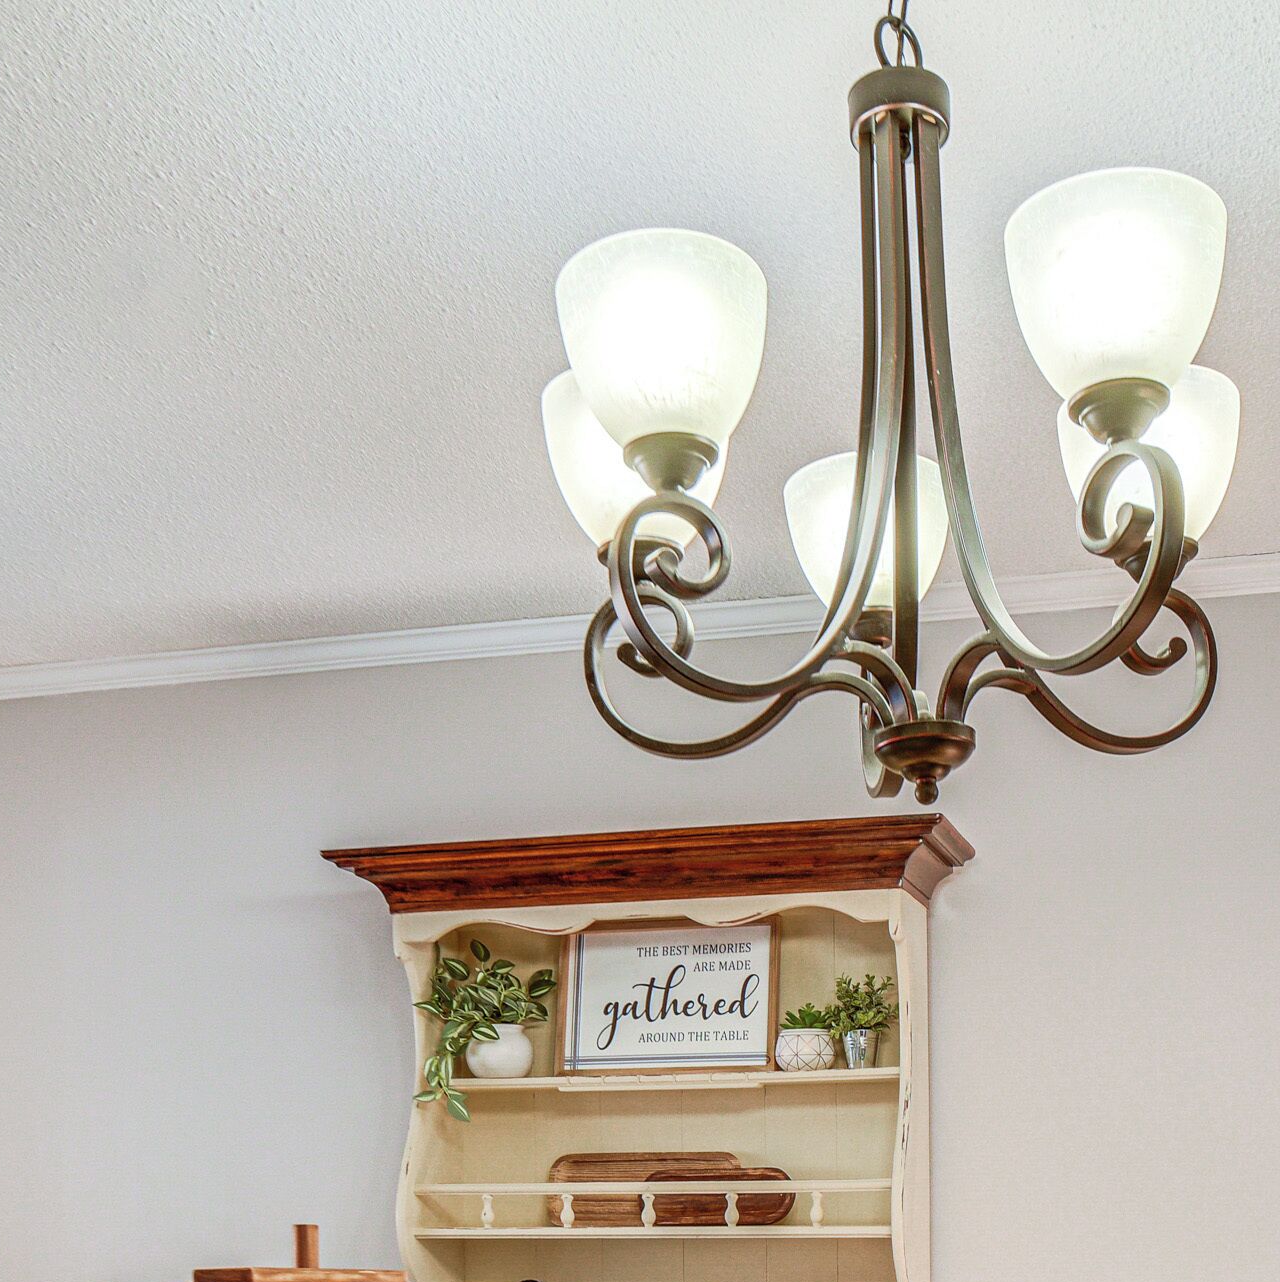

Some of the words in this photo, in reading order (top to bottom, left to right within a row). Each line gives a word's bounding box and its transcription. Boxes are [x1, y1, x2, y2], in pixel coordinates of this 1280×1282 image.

[636, 946, 659, 958] THE
[662, 944, 690, 957] BEST
[692, 942, 752, 955] MEMORIES
[693, 961, 716, 973] ARE
[718, 959, 752, 972] MADE
[596, 964, 760, 1051] gathered
[638, 1031, 685, 1043] AROUND
[687, 1031, 711, 1042] THE
[713, 1030, 750, 1042] TABLE
